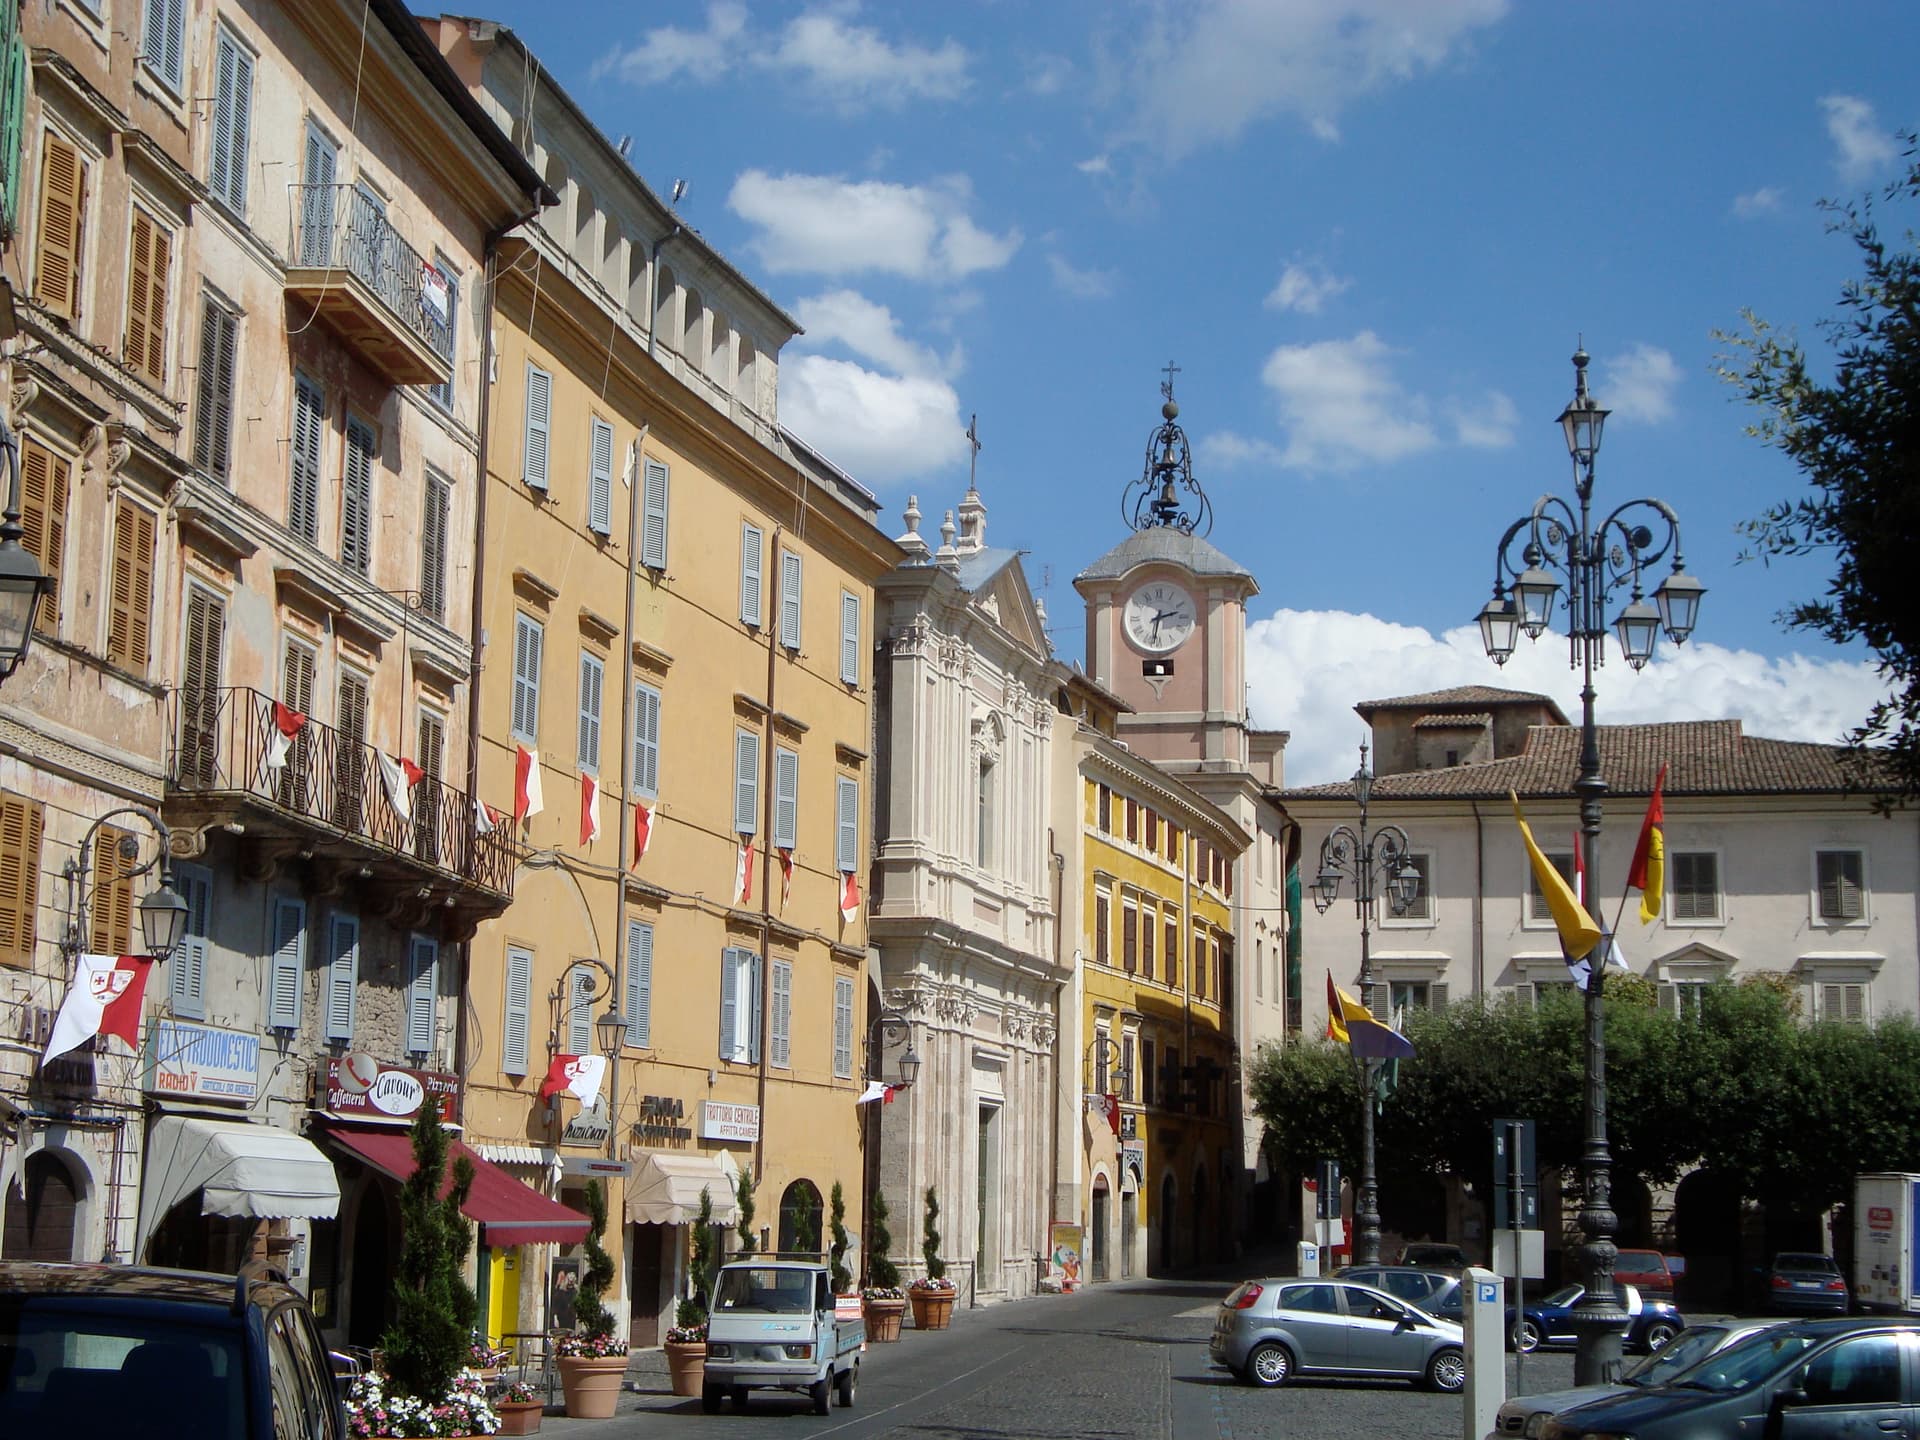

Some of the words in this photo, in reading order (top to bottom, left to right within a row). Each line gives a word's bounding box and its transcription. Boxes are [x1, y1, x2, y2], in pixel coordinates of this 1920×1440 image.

[159, 1072, 189, 1091] RADIO
[328, 1087, 366, 1109] Caffetteria
[706, 1104, 733, 1122] TRATTORIA
[1307, 1250, 1315, 1259] P
[1481, 1285, 1494, 1301] P
